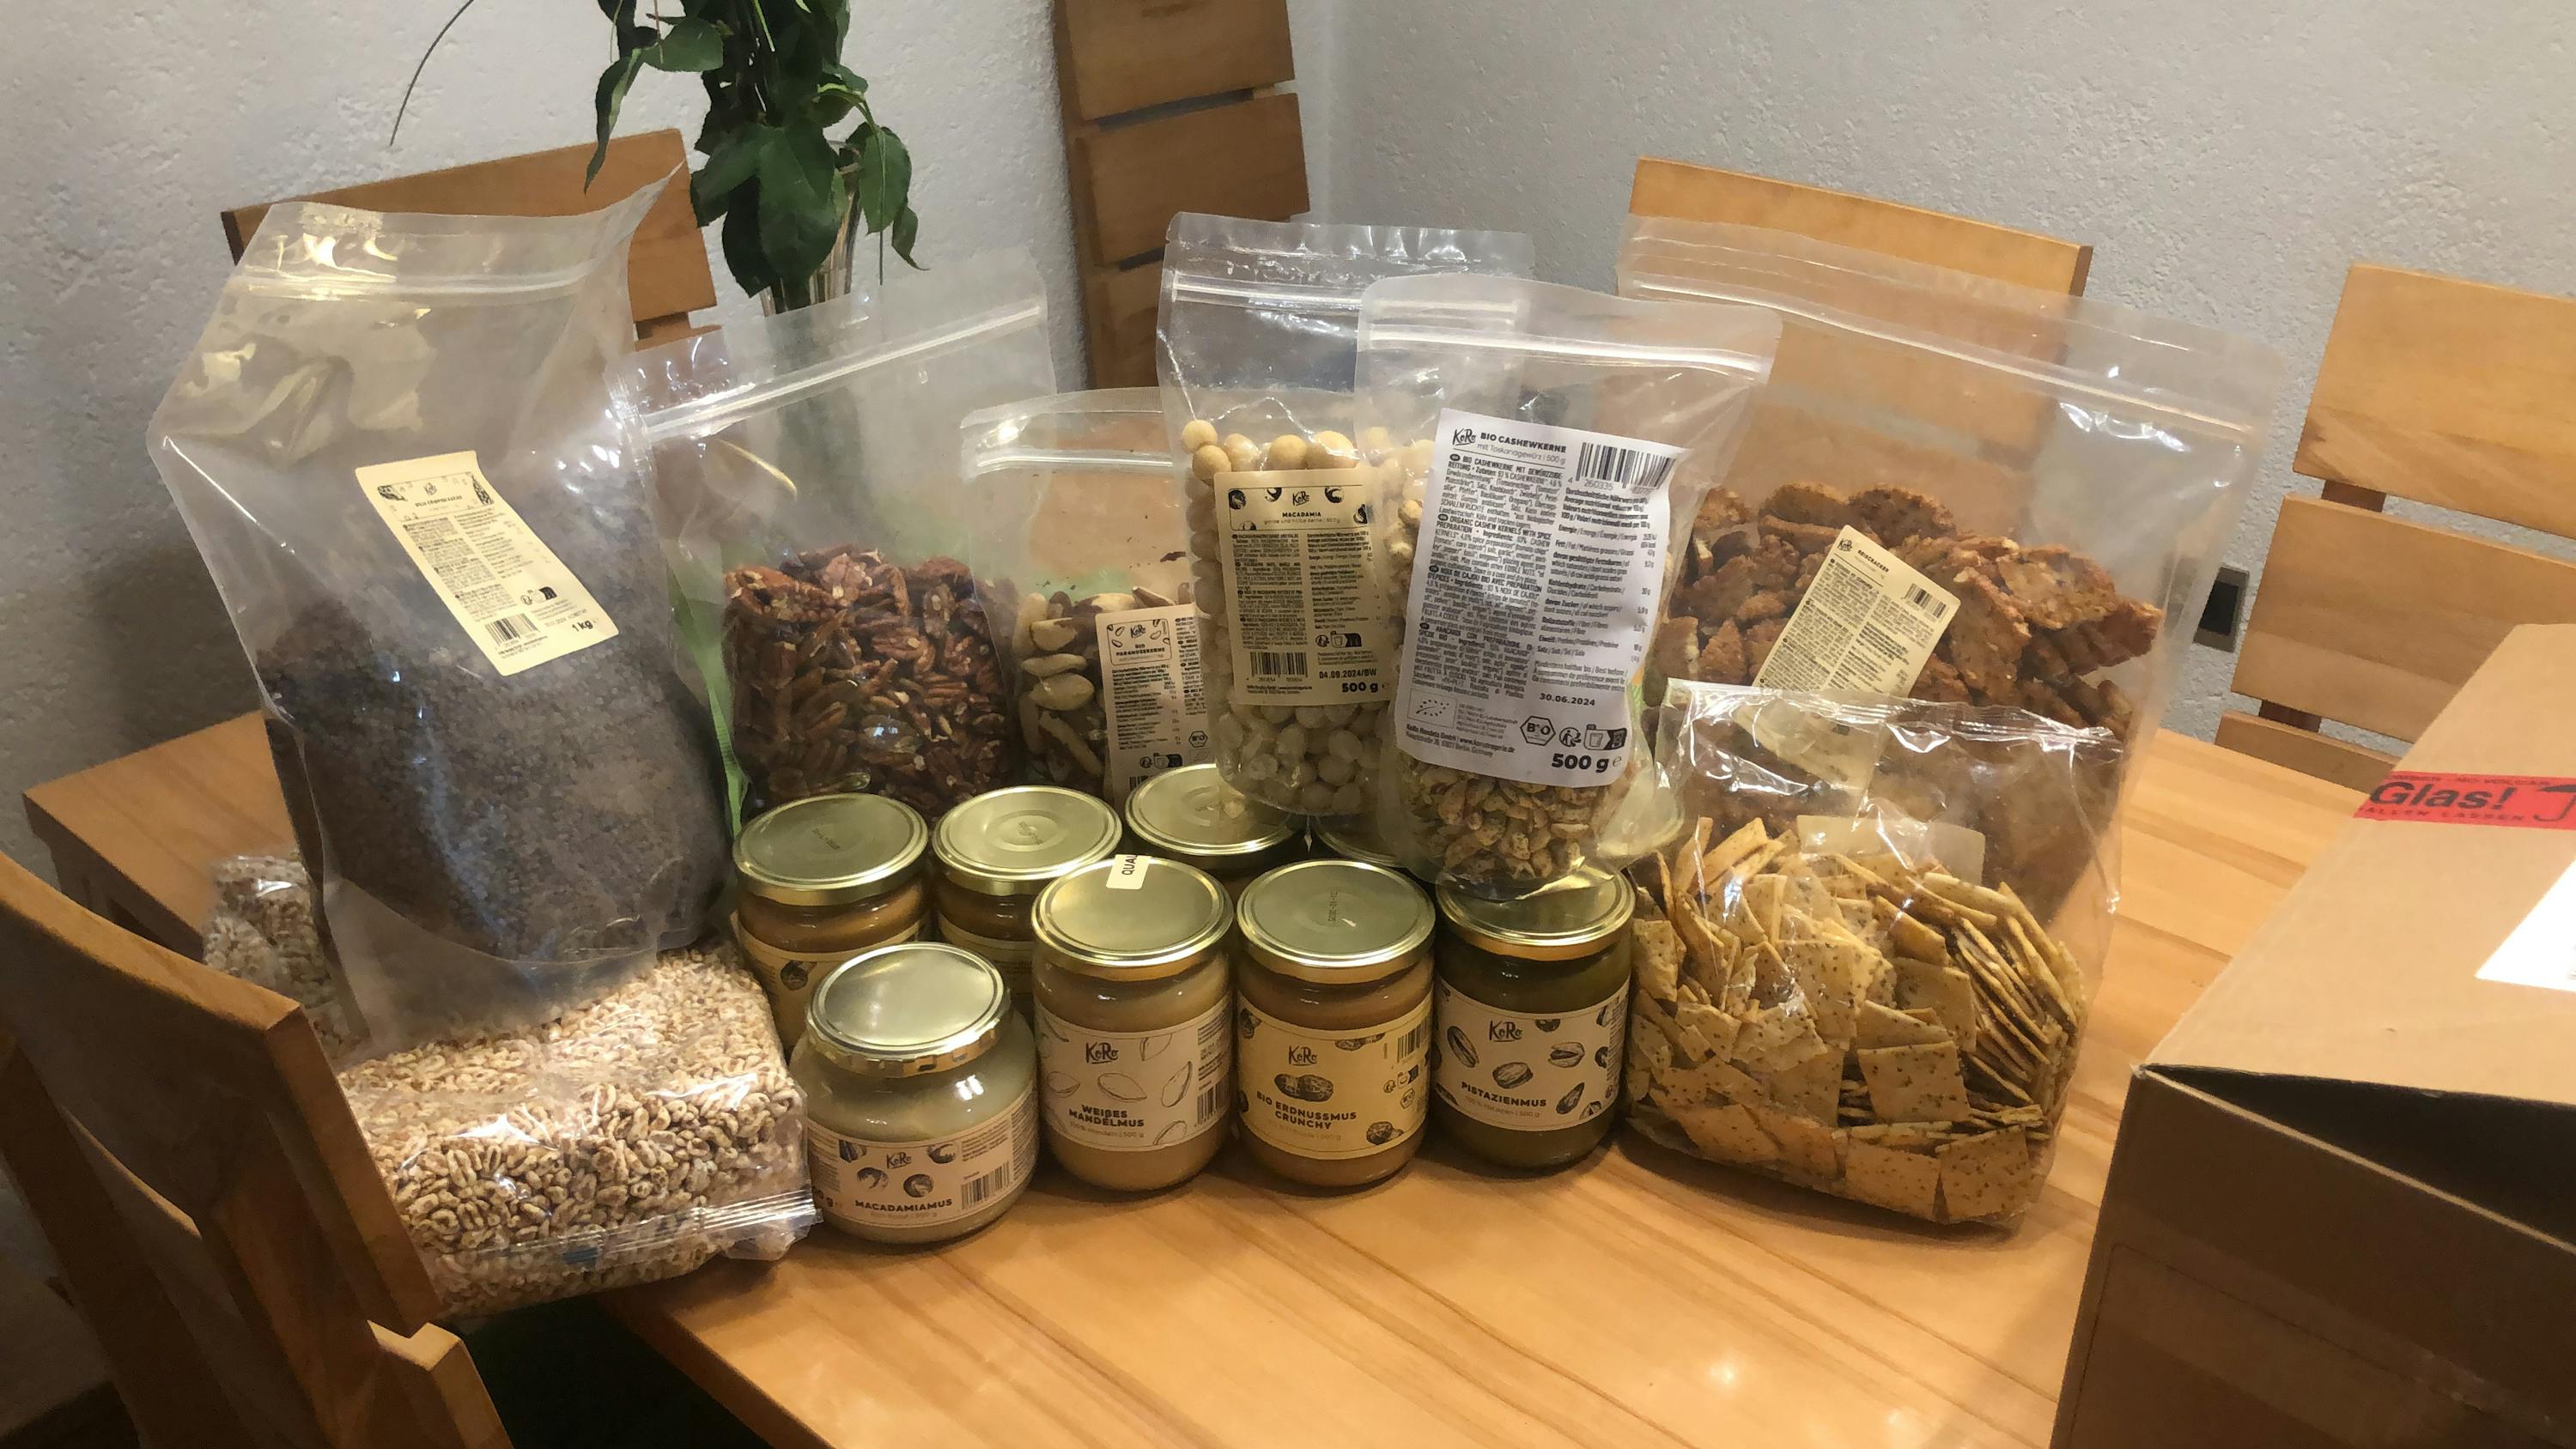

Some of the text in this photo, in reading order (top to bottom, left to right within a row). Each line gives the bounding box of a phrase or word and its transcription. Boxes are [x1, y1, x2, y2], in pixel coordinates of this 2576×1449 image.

[1453, 428, 1476, 446] KoRo
[1481, 433, 1566, 453] BIO CASHEWKERNE
[1477, 443, 1488, 452] mit
[1490, 445, 1541, 460] Toskanagewürz
[1437, 521, 1472, 533] PREPARATION
[1449, 516, 1473, 526] ORGANIC
[1475, 521, 1496, 530] CASHEW
[577, 620, 593, 630] kg
[1319, 669, 1376, 679] 04.09.2024/BW
[1342, 682, 1378, 693] 500 g
[1540, 693, 1595, 706] 30.06.2024
[1552, 754, 1591, 769] 500
[1596, 759, 1608, 773] g
[2370, 781, 2518, 809] Glas!
[1489, 1020, 1522, 1043] KoRo
[1085, 1041, 1119, 1064] KoRo
[1288, 1045, 1318, 1066] KoRo
[1461, 1082, 1546, 1106] PISTAZIENMUS
[1257, 1091, 1357, 1120] BIO ERDNUSSMUS
[1069, 1108, 1145, 1126] MANDELMUS
[1275, 1111, 1331, 1129] CRUNCHY
[886, 1152, 913, 1169] KoRo
[855, 1198, 953, 1212] MACADAMIAMUS
